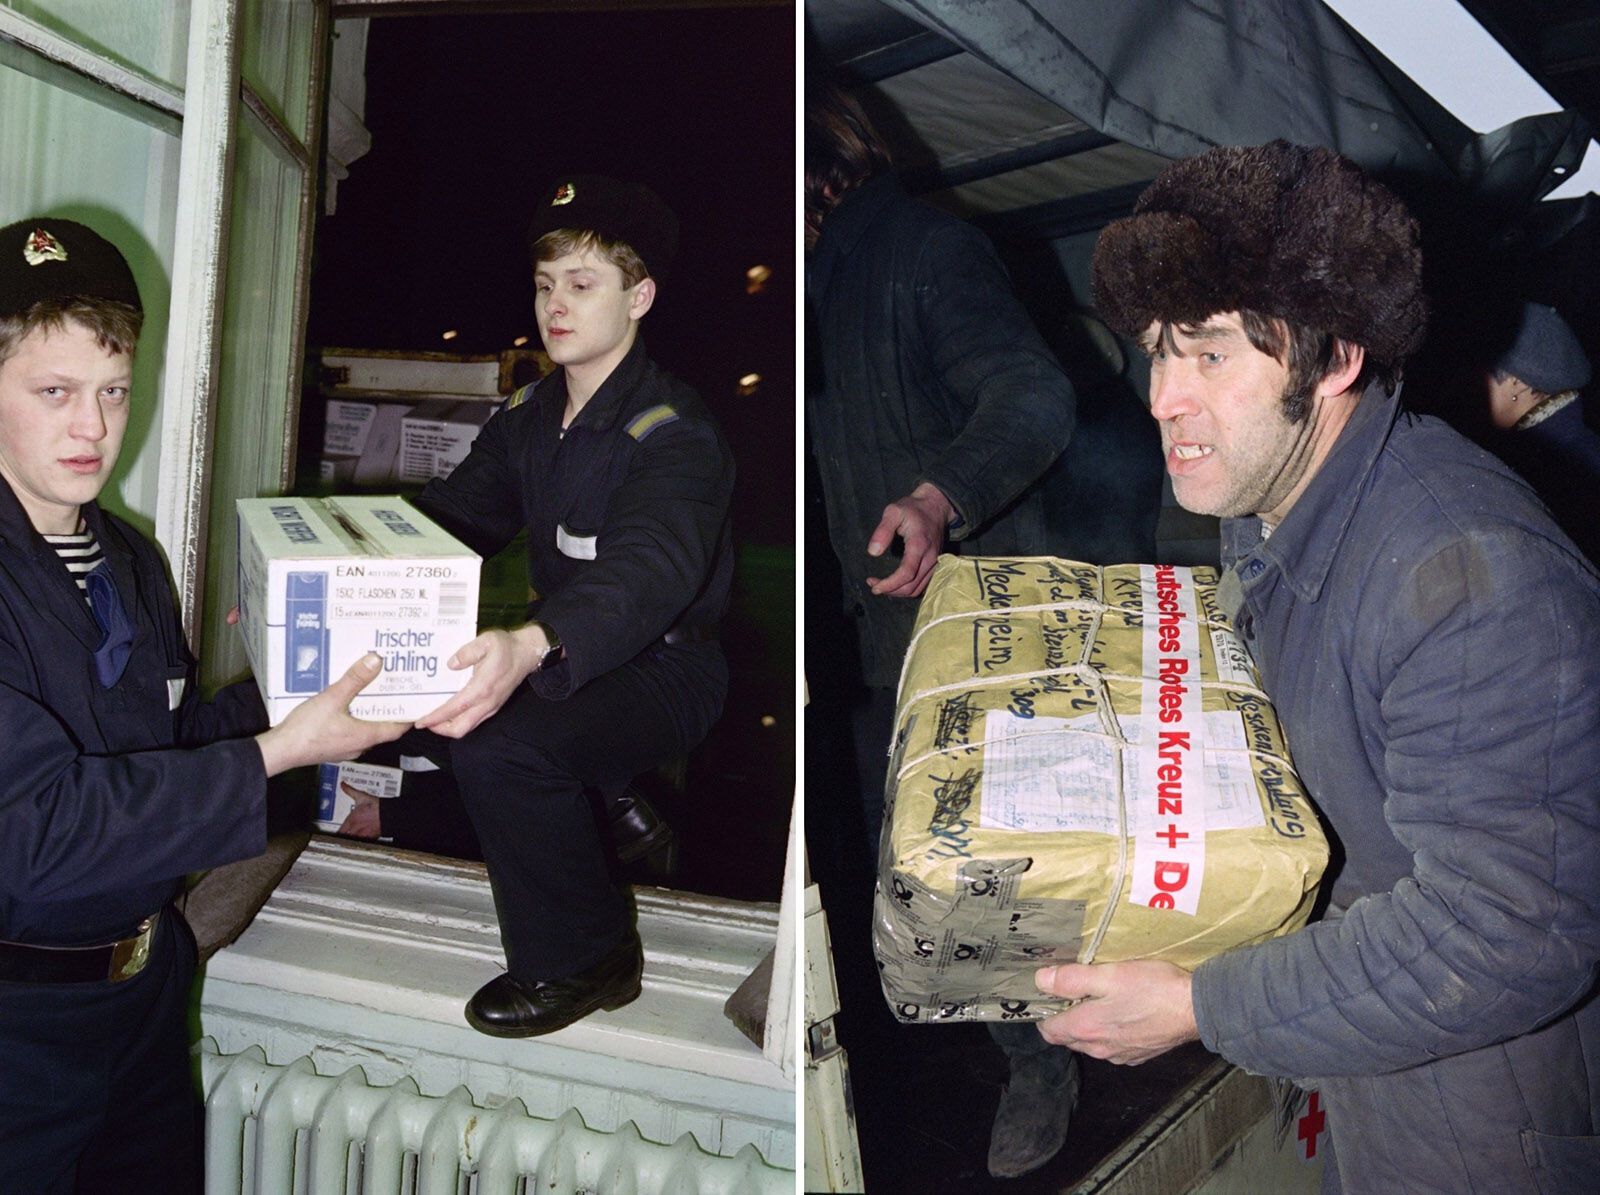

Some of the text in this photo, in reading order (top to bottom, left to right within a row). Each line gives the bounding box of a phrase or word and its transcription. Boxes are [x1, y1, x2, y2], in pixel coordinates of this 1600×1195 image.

[336, 566, 366, 578] EAN
[405, 567, 452, 578] 27360
[358, 588, 397, 600] FLASCHEN
[374, 628, 436, 649] Irischer
[367, 649, 439, 679] ühling
[1158, 658, 1189, 724] Rotes
[350, 704, 406, 716] tivfrisch
[1157, 730, 1191, 816] Kreuz
[1149, 859, 1188, 910] De
